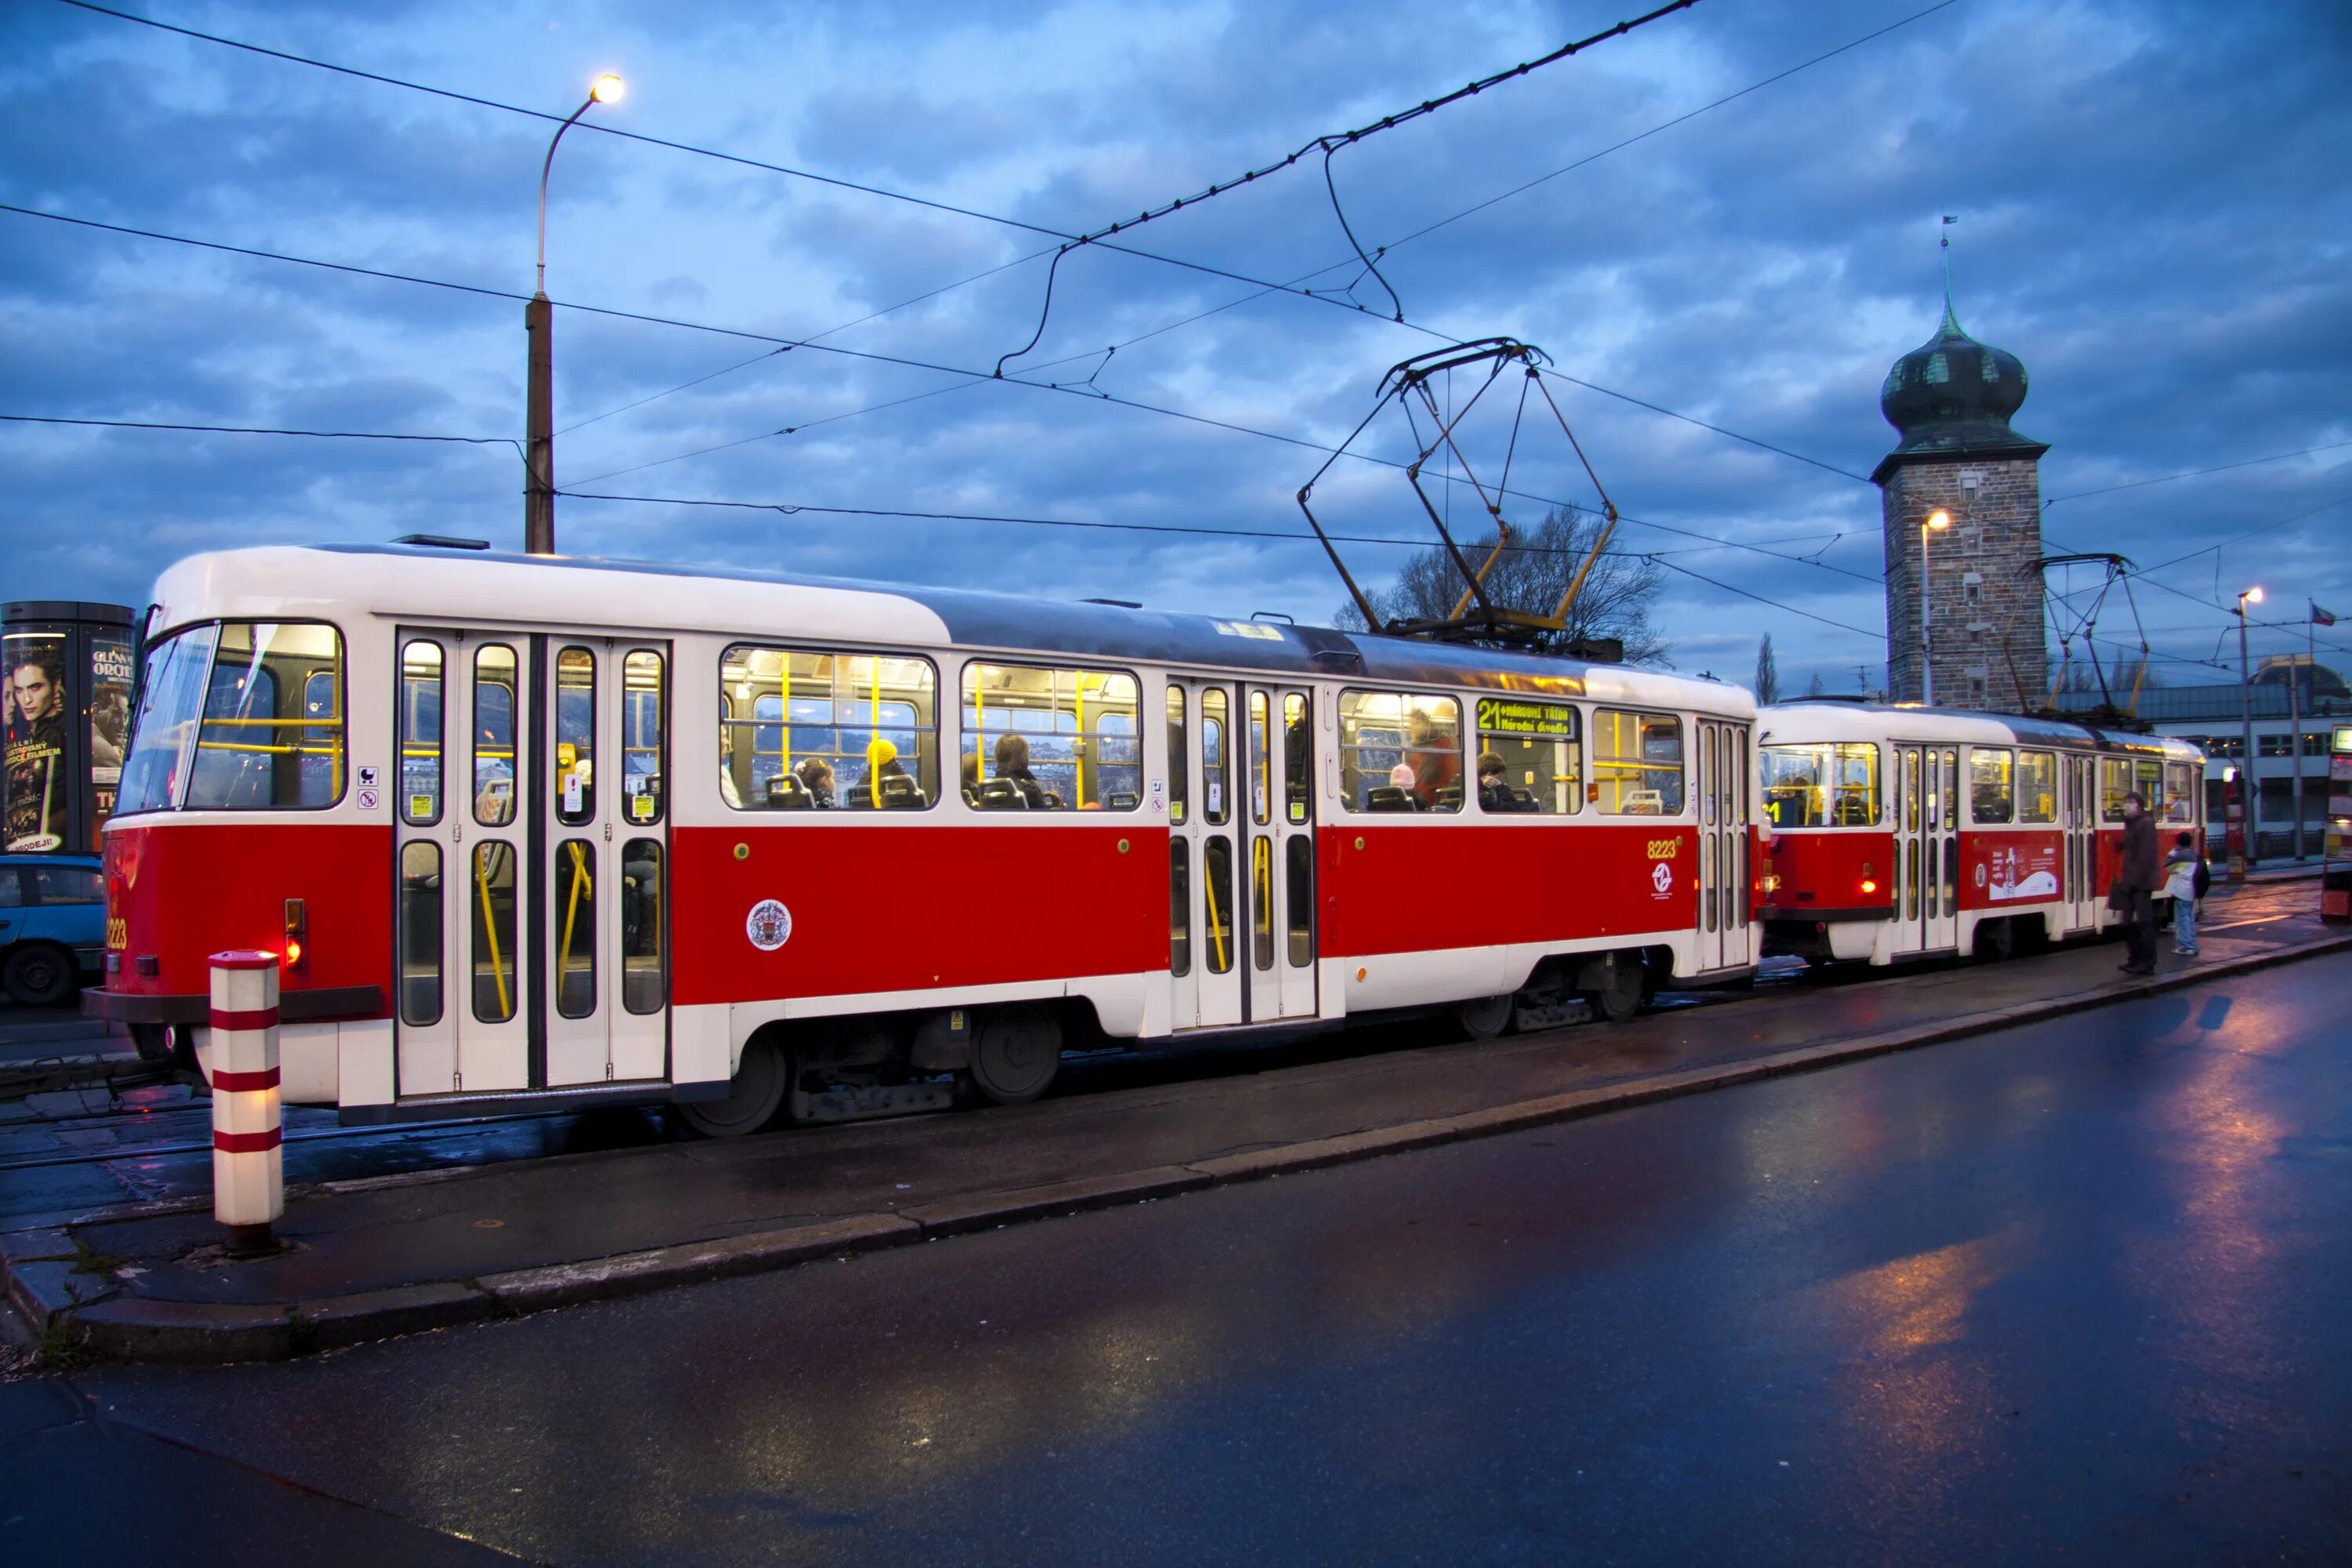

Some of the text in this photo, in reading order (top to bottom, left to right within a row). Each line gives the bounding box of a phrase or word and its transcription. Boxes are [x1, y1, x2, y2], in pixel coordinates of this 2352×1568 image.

[93, 651, 127, 663] GLENN
[1478, 700, 1500, 730] 21
[1501, 718, 1568, 734] Národní divadlo
[27, 747, 61, 759] FILMEM
[1647, 840, 1675, 859] 8223
